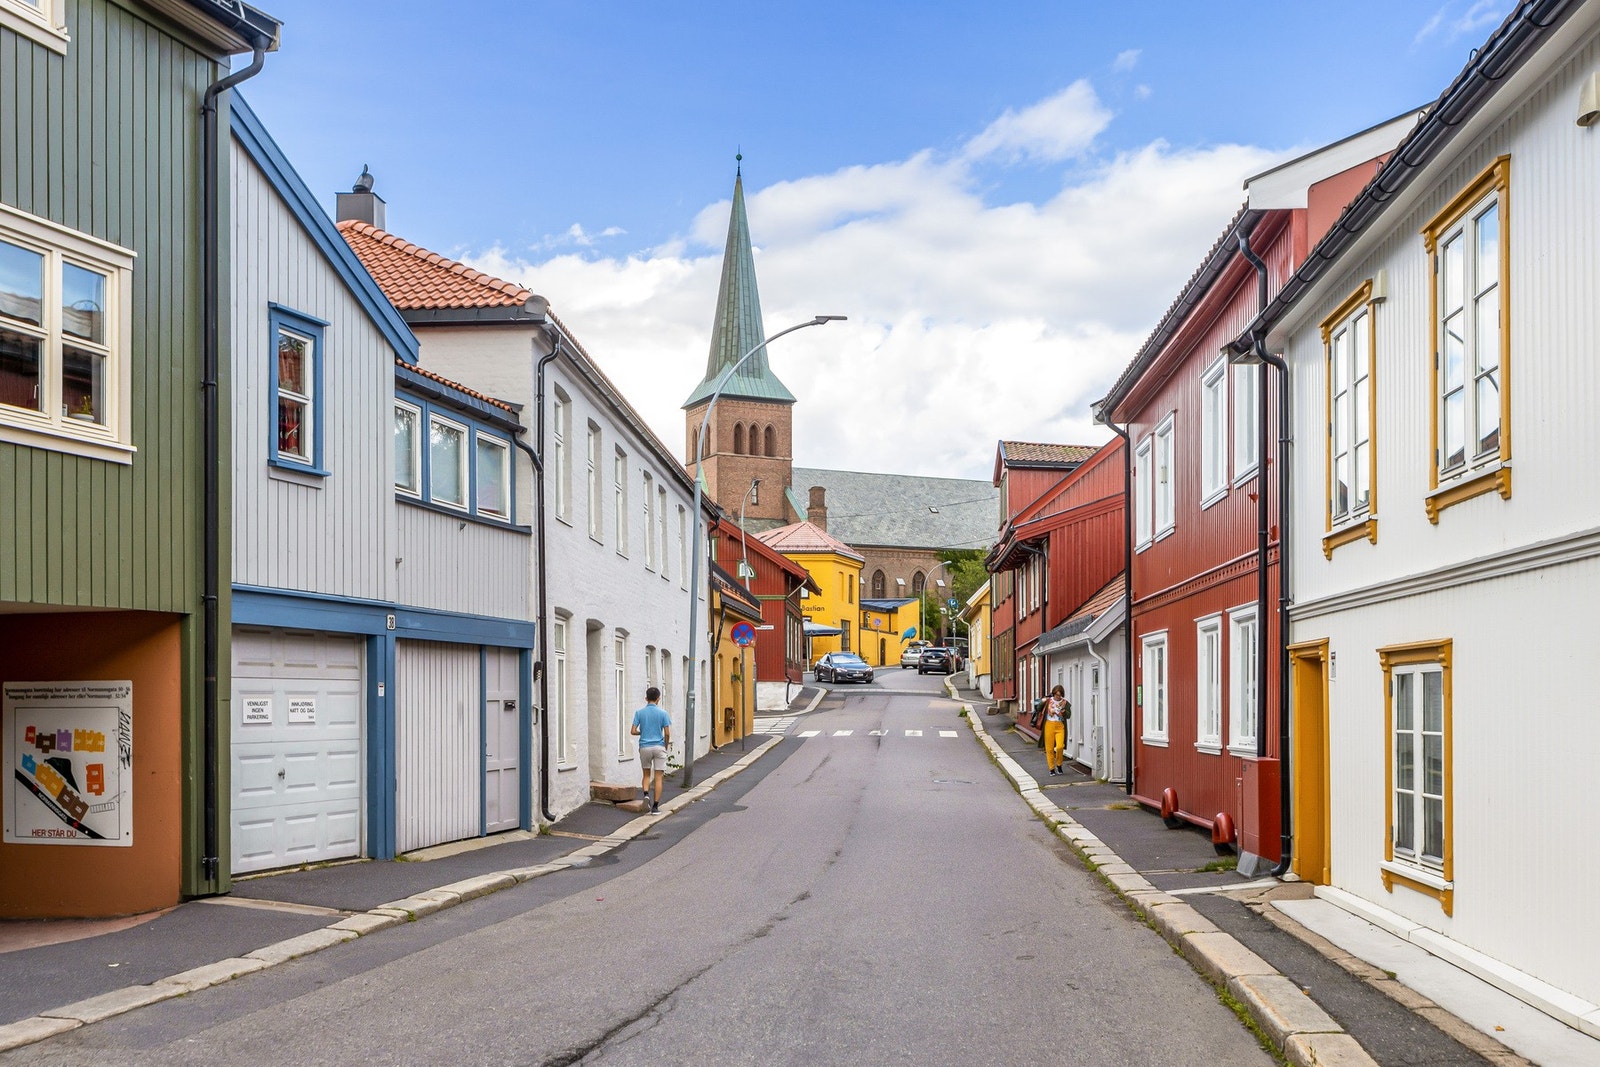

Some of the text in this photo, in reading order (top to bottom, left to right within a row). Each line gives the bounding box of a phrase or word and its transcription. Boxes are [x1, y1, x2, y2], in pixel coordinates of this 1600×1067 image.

[31, 828, 77, 837] HER STÅR DU
